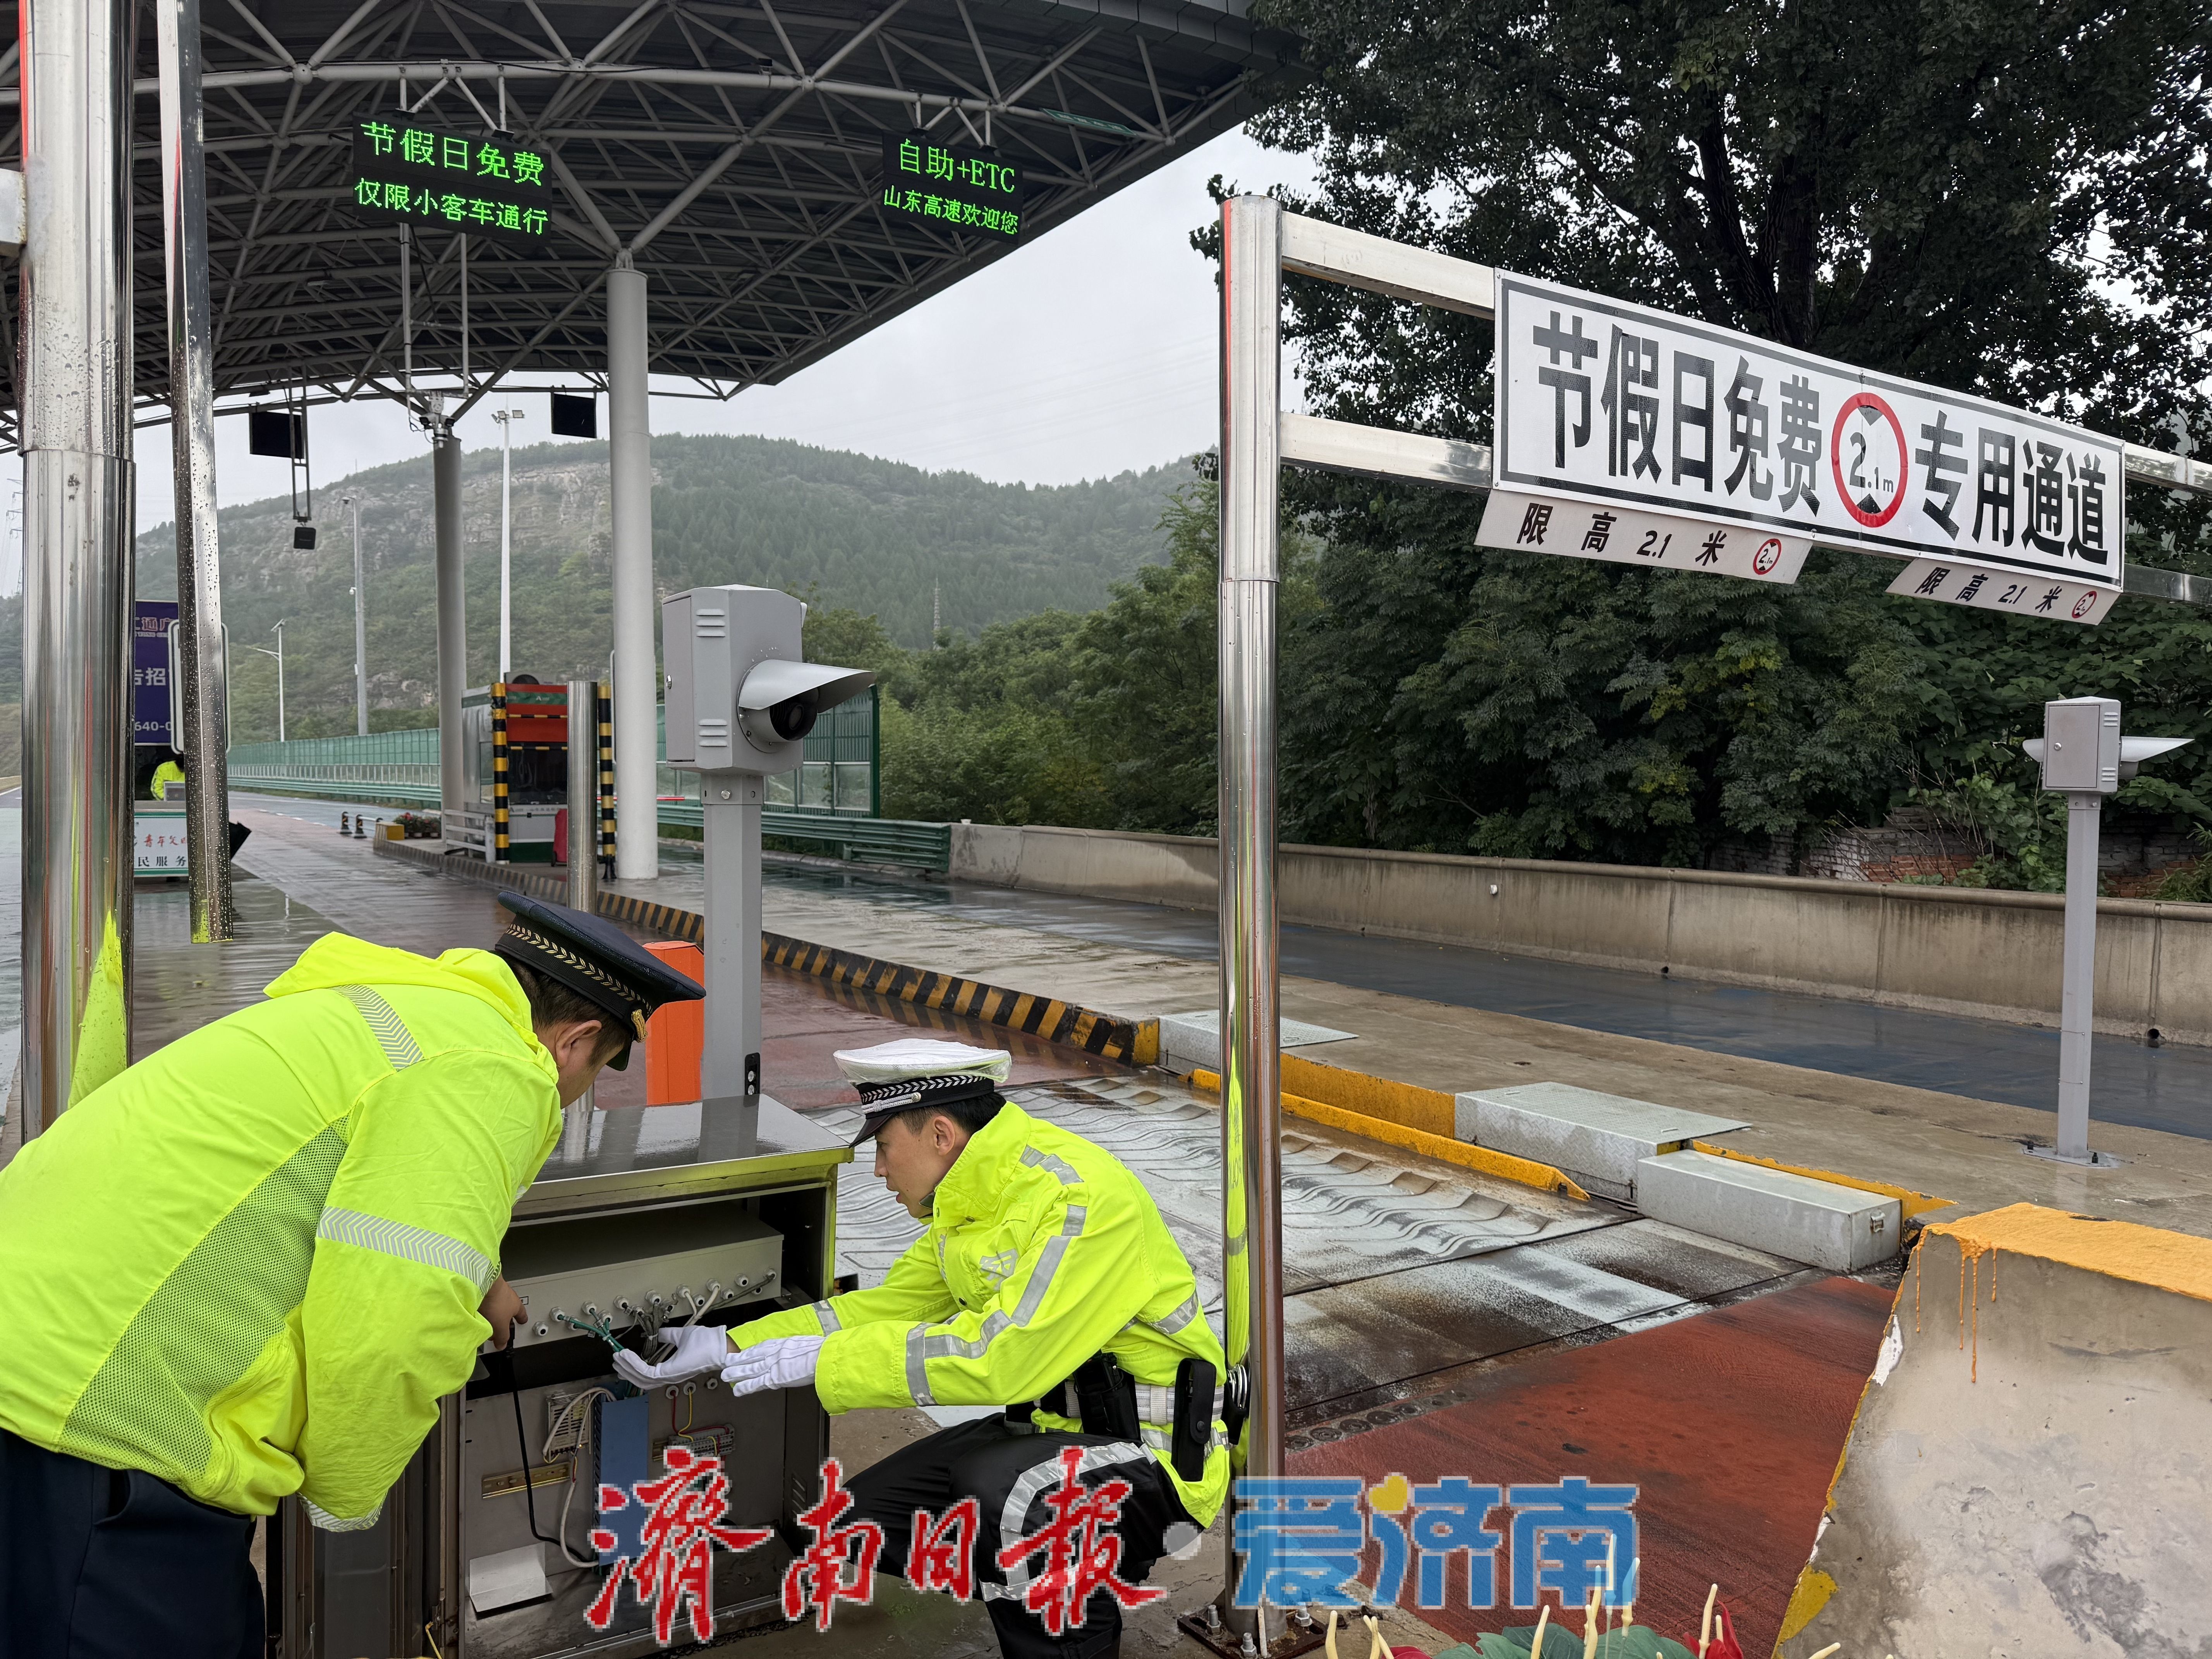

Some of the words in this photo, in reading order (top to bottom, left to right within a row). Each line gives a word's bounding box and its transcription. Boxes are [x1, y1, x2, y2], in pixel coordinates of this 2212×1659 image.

[361, 122, 544, 186] 节假日免费
[900, 139, 1015, 193] 自助+ETC
[355, 178, 548, 235] 仅限小客车通行
[884, 185, 1018, 235] 山东高速欢迎您
[1532, 310, 1822, 517] 节假日免费
[1915, 410, 2109, 565] 专用通道
[138, 855, 186, 867] 民服务
